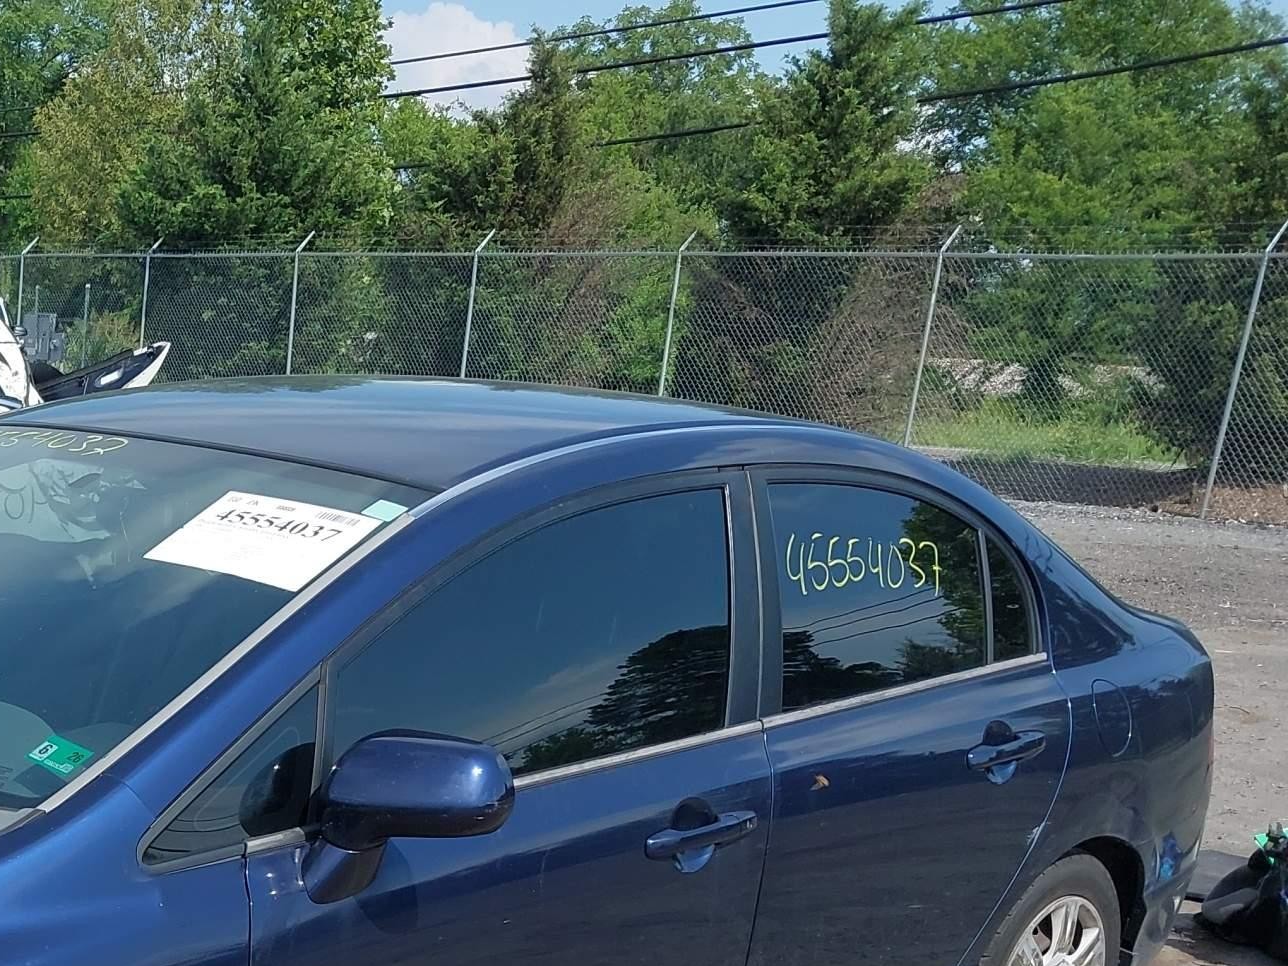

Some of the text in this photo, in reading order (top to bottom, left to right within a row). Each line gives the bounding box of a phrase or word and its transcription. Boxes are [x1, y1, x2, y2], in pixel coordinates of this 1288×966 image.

[215, 509, 343, 542] 45554037
[785, 532, 943, 598] 45554037
[38, 744, 53, 755] 6
[68, 752, 85, 763] 26
